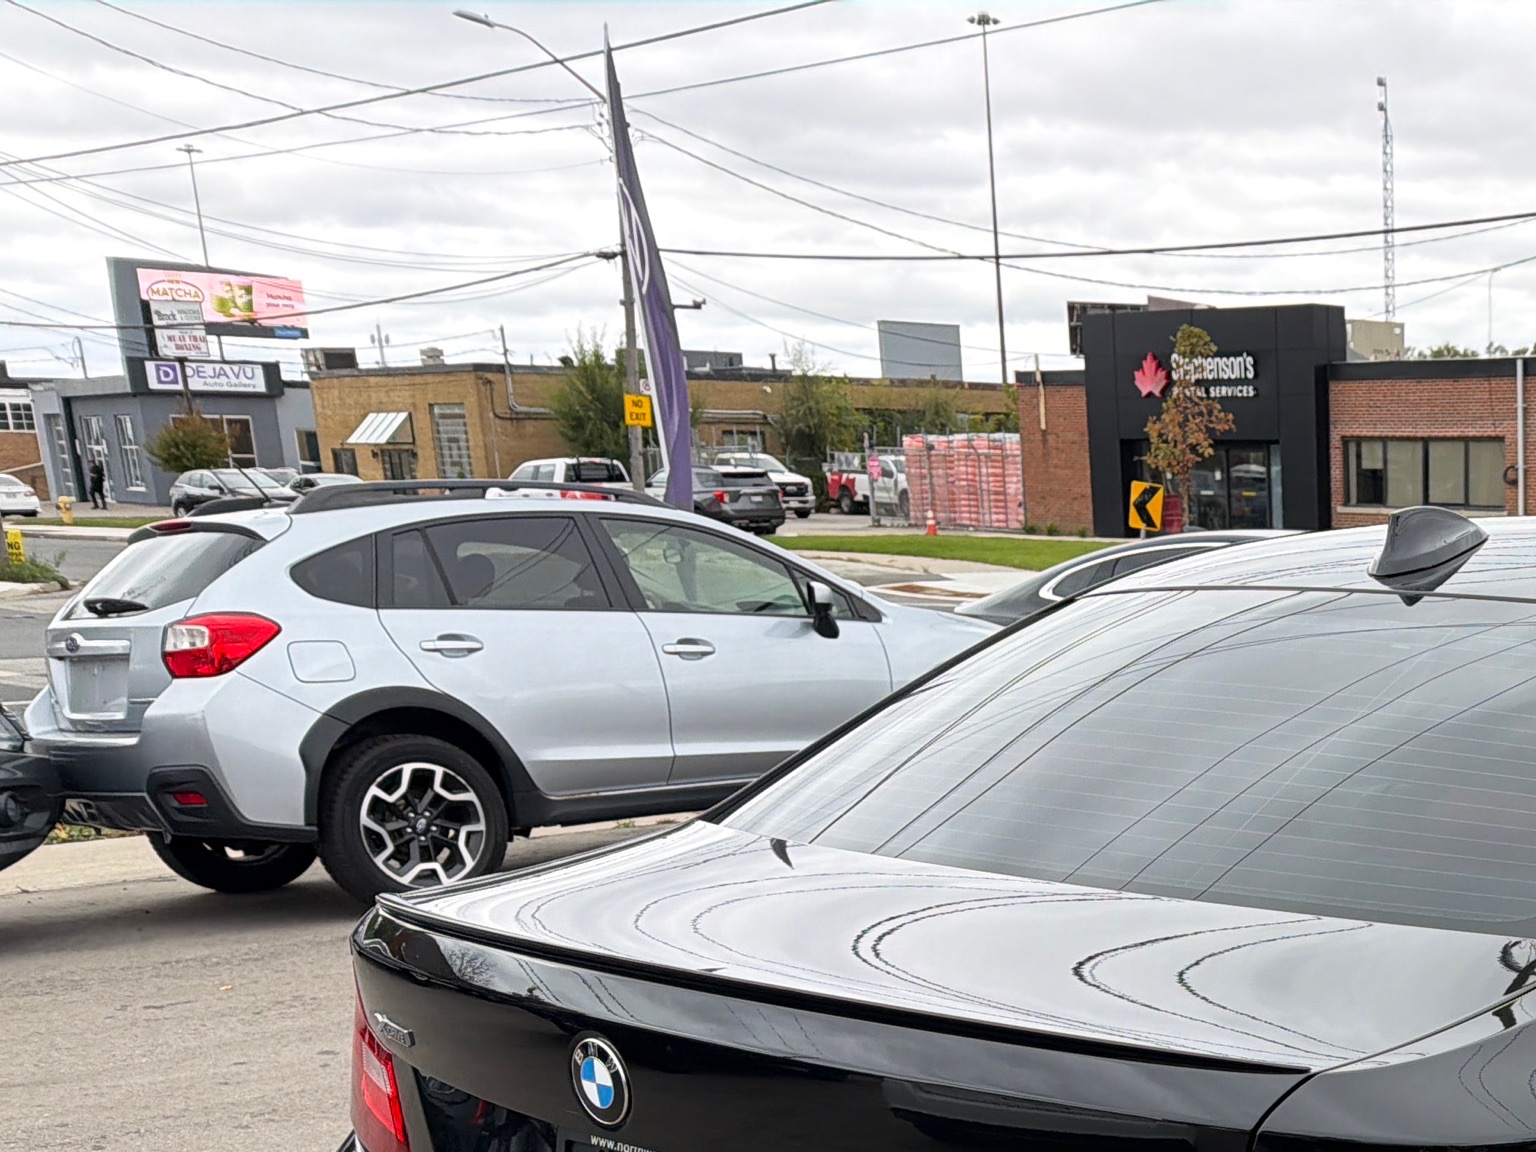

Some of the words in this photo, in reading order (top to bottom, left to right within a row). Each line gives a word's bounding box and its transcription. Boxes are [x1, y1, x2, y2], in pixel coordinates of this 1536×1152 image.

[150, 286, 201, 299] MATCHA
[226, 381, 257, 390] Gallery
[1209, 385, 1255, 398] SERVICES
[631, 398, 644, 409] NO
[629, 411, 647, 422] EXIT
